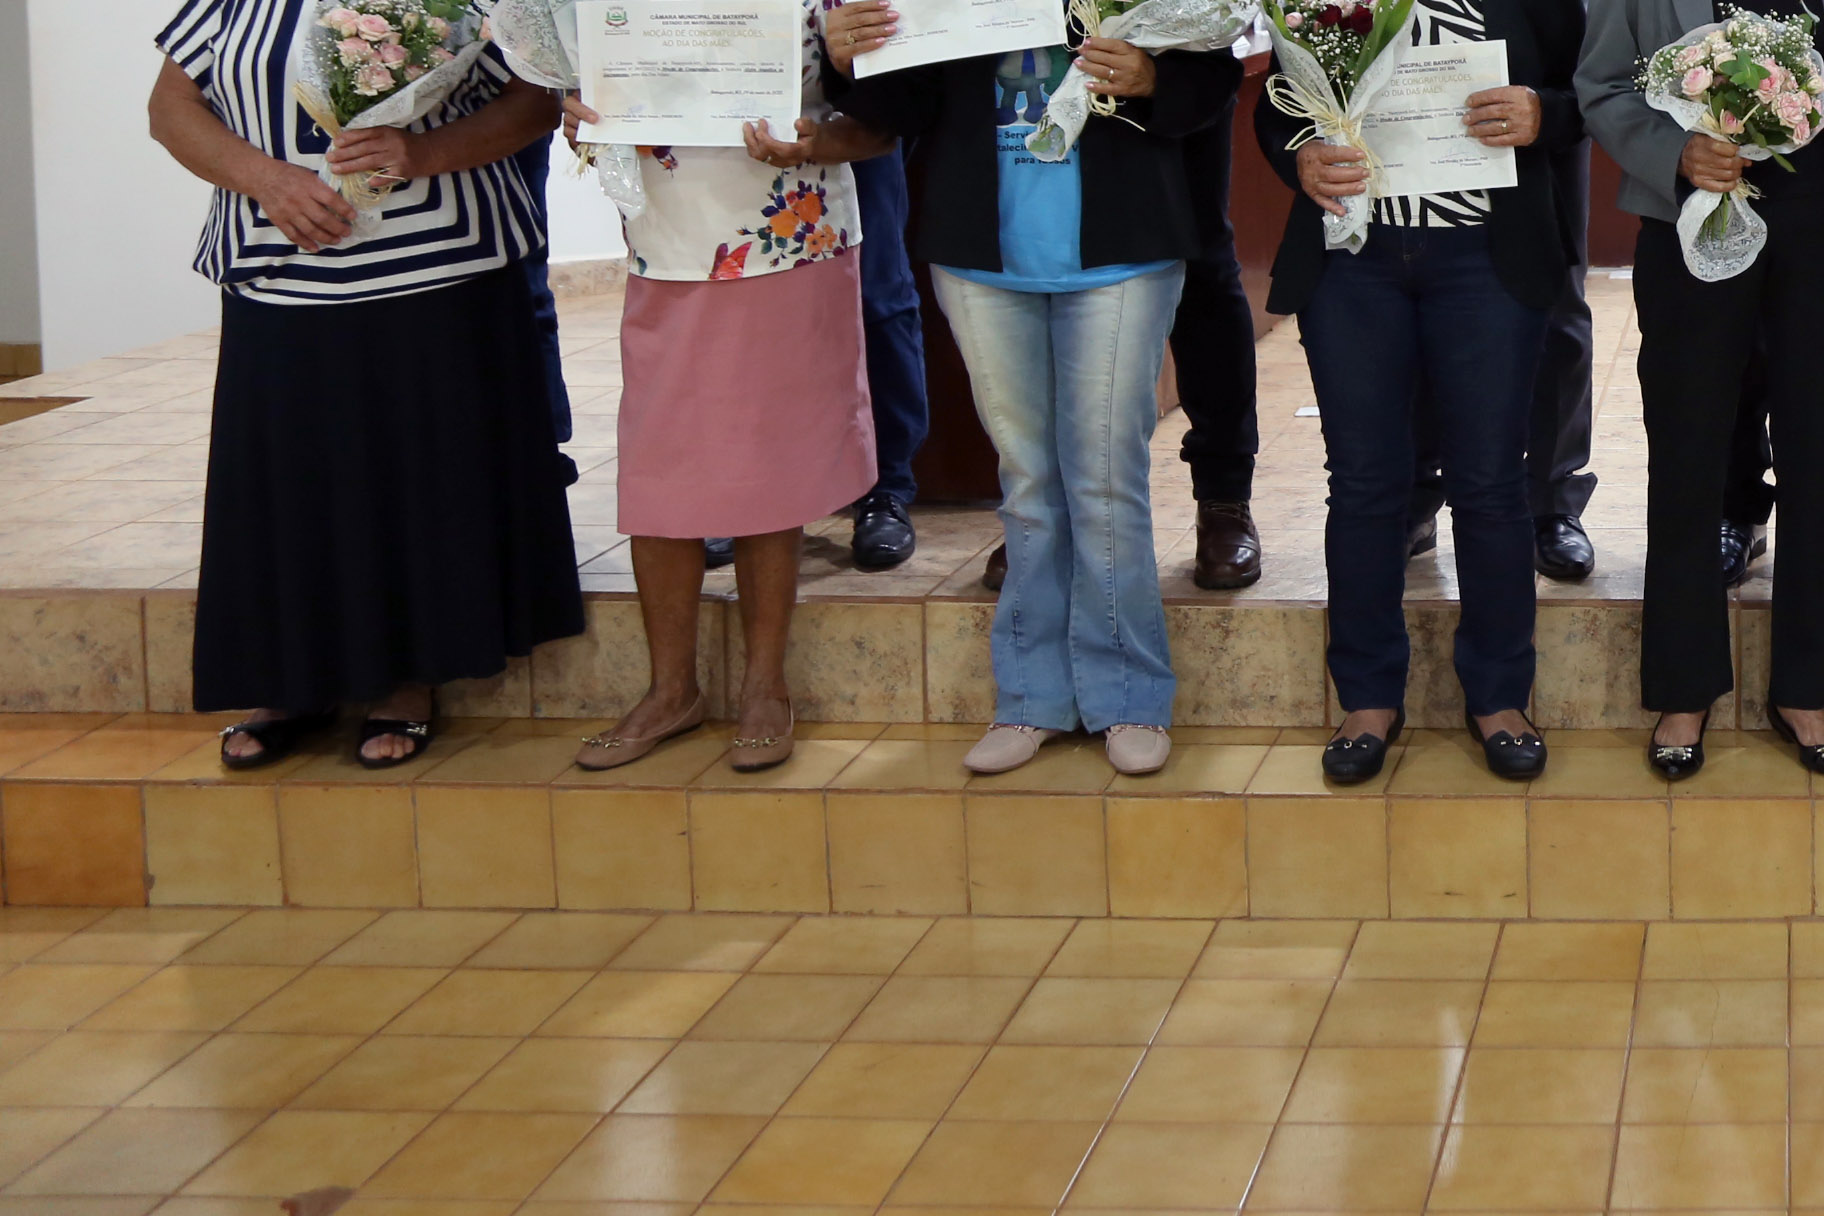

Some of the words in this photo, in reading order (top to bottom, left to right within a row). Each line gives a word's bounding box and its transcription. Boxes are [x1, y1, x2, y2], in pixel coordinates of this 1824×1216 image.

[1391, 79, 1400, 87] DE
[1392, 89, 1404, 97] DIA
[1406, 87, 1421, 96] DAS
[1014, 157, 1036, 165] para
